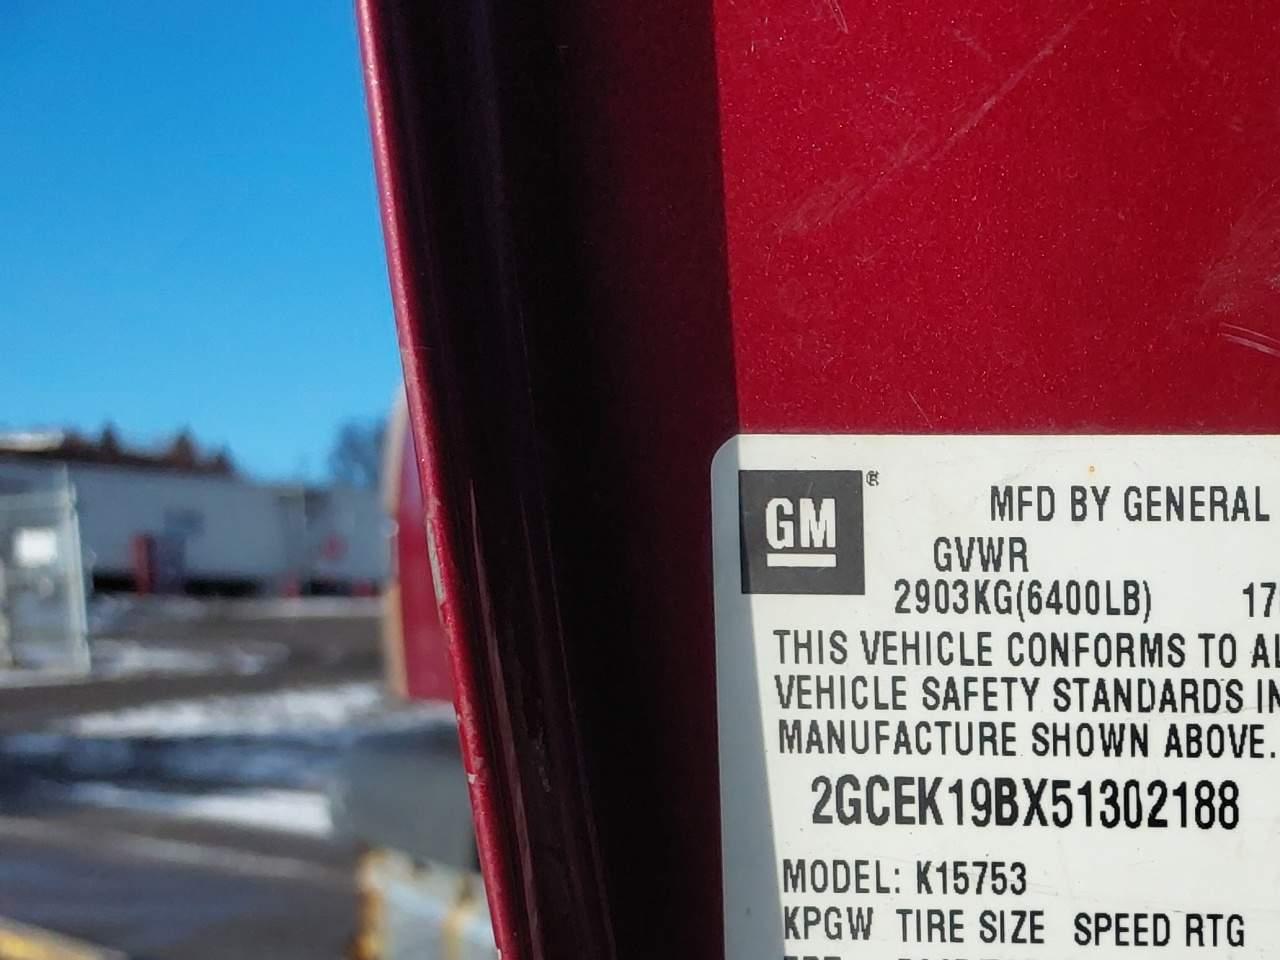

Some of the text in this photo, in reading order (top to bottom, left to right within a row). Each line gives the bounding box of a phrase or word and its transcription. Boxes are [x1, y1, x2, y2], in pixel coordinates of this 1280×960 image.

[991, 486, 1055, 521] MFD
[1071, 486, 1111, 521] BY
[1124, 486, 1270, 521] GENERAL
[766, 498, 836, 549] GM
[934, 537, 1028, 572] GVWR
[895, 579, 1151, 623] 2903KG(6400LB)
[773, 630, 847, 664] THIS
[860, 631, 992, 666] VEHICLE
[1008, 632, 1185, 668] CONFORMS
[1198, 633, 1236, 668] TO
[774, 675, 906, 710] VEHICLE
[922, 676, 1040, 712] SAFETY
[1053, 677, 1243, 713] STANDARDS
[779, 719, 1275, 758] MANUFACTURE SHOWN ABOVE.
[812, 774, 1239, 830] 2GCEK19BX51302188
[783, 859, 1026, 895] MODEL: K15753
[785, 906, 1244, 947] KPGW TIRE SIZE SPEED RTG
